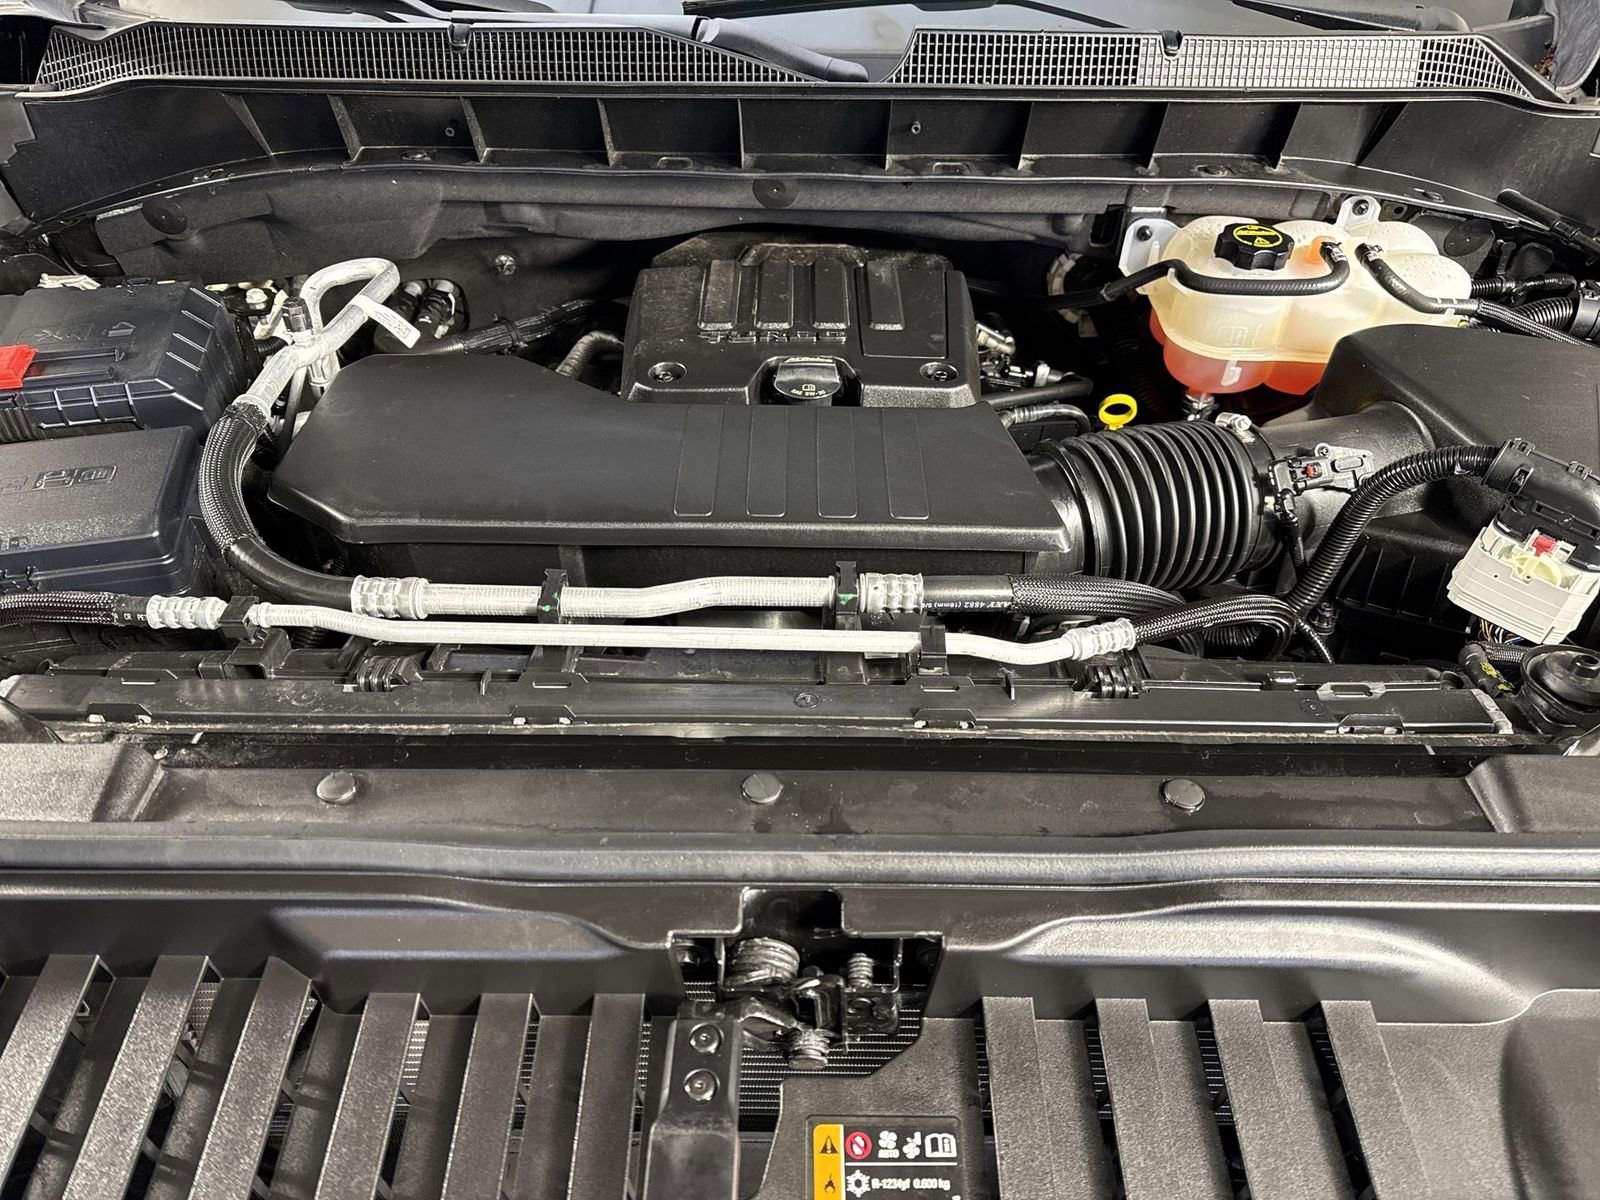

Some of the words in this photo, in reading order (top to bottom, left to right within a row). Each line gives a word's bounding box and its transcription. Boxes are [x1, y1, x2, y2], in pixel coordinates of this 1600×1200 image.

[964, 601, 986, 609] 4882
[871, 1178, 910, 1191] R-1234yf
[913, 1178, 937, 1189] 0.600
[938, 1178, 950, 1191] kg
